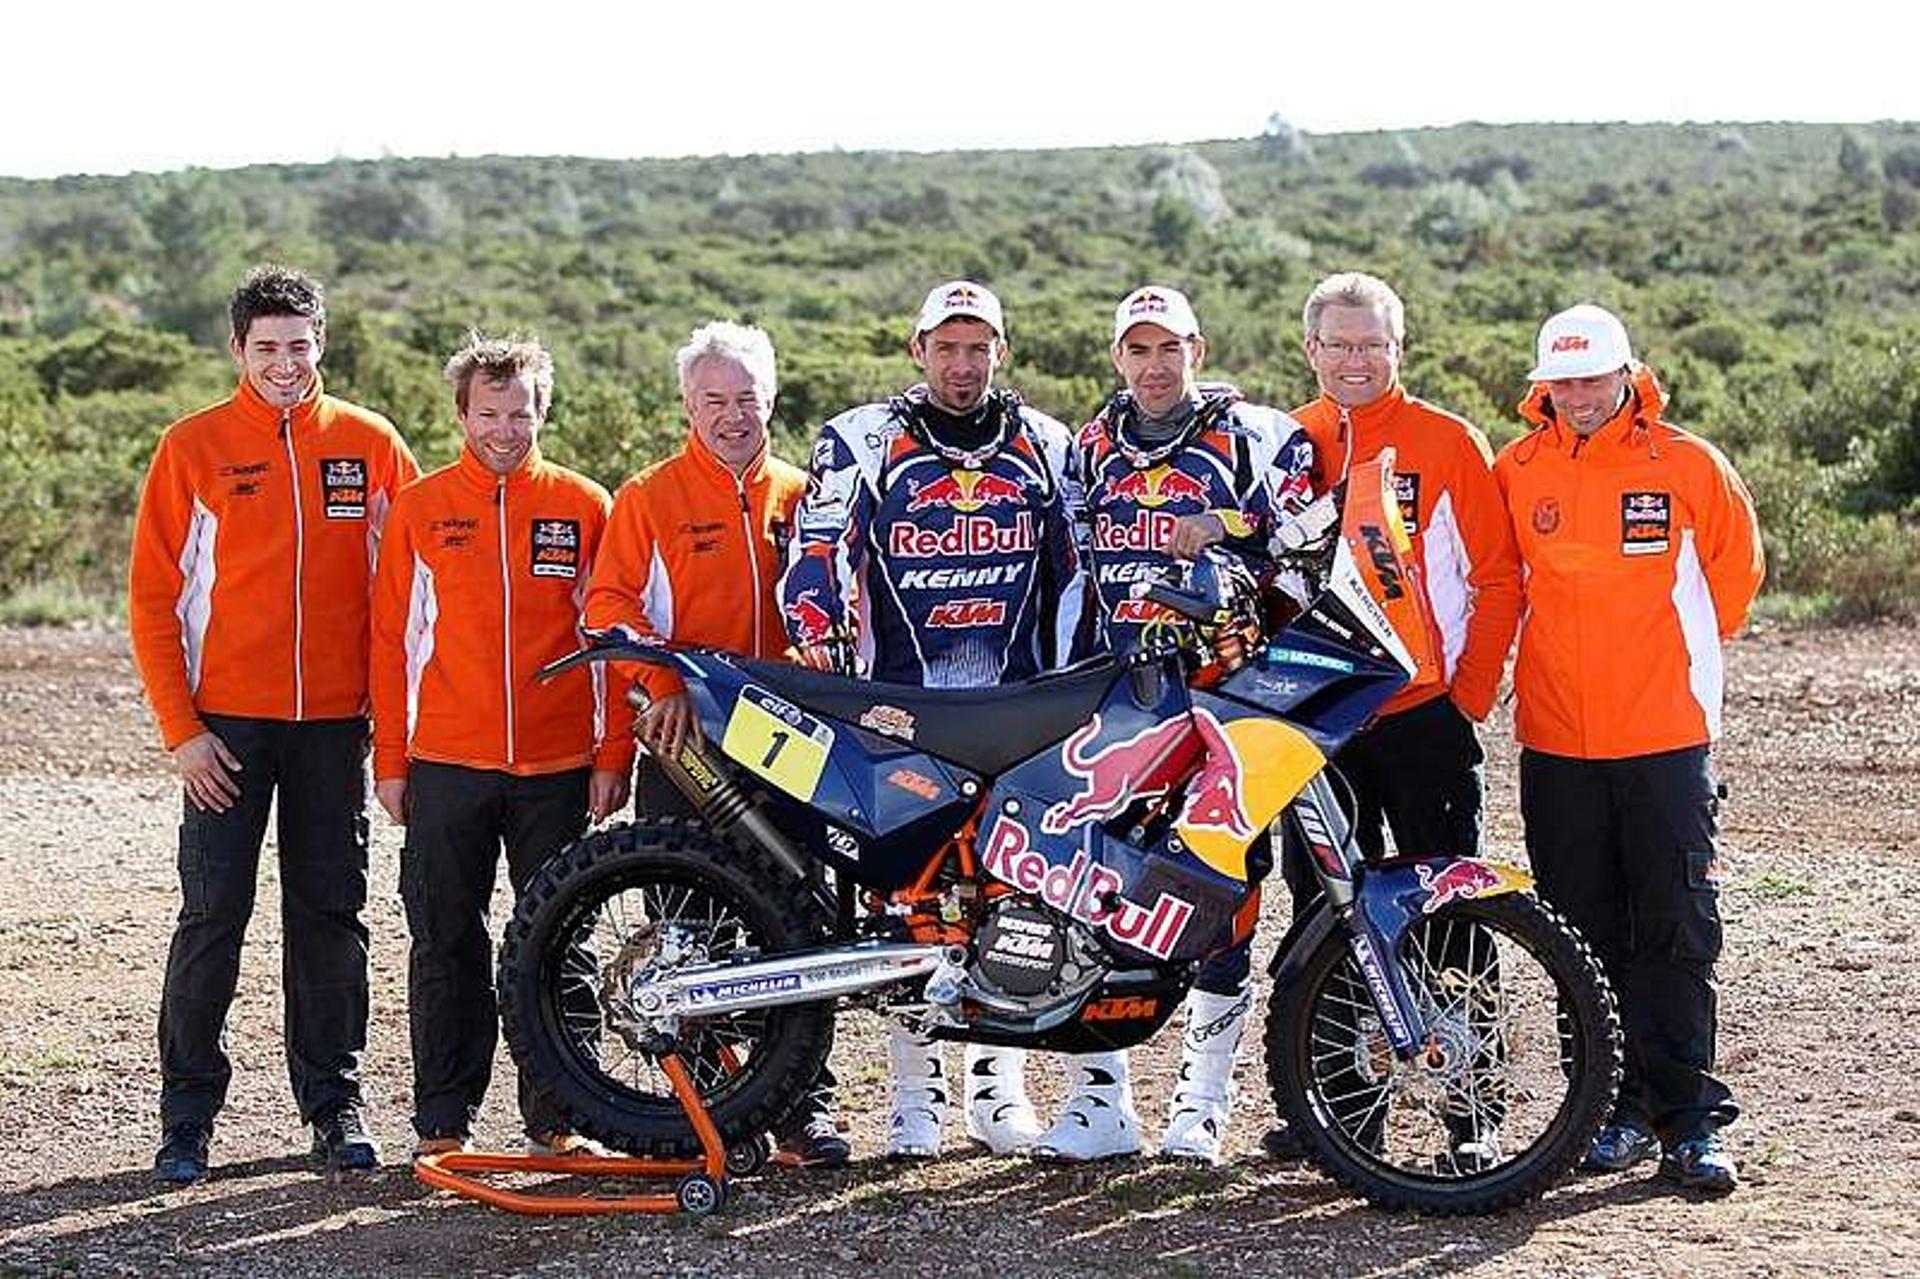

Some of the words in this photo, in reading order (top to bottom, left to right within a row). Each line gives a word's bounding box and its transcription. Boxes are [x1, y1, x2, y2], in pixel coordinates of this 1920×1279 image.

[1551, 336, 1590, 352] KTM
[889, 515, 964, 558] Red
[967, 511, 1036, 553] Bull
[1094, 509, 1150, 551] Red
[900, 562, 1025, 590] KENNY
[1360, 525, 1404, 600] KTM
[925, 598, 1006, 628] KTM
[761, 730, 790, 769] 1
[982, 814, 1090, 914] Red
[1071, 863, 1195, 961] Bull
[994, 933, 1054, 959] KTM
[716, 974, 798, 998] MICHELIN
[1363, 962, 1407, 1040] MICHELIN
[1083, 996, 1158, 1021] KTM
